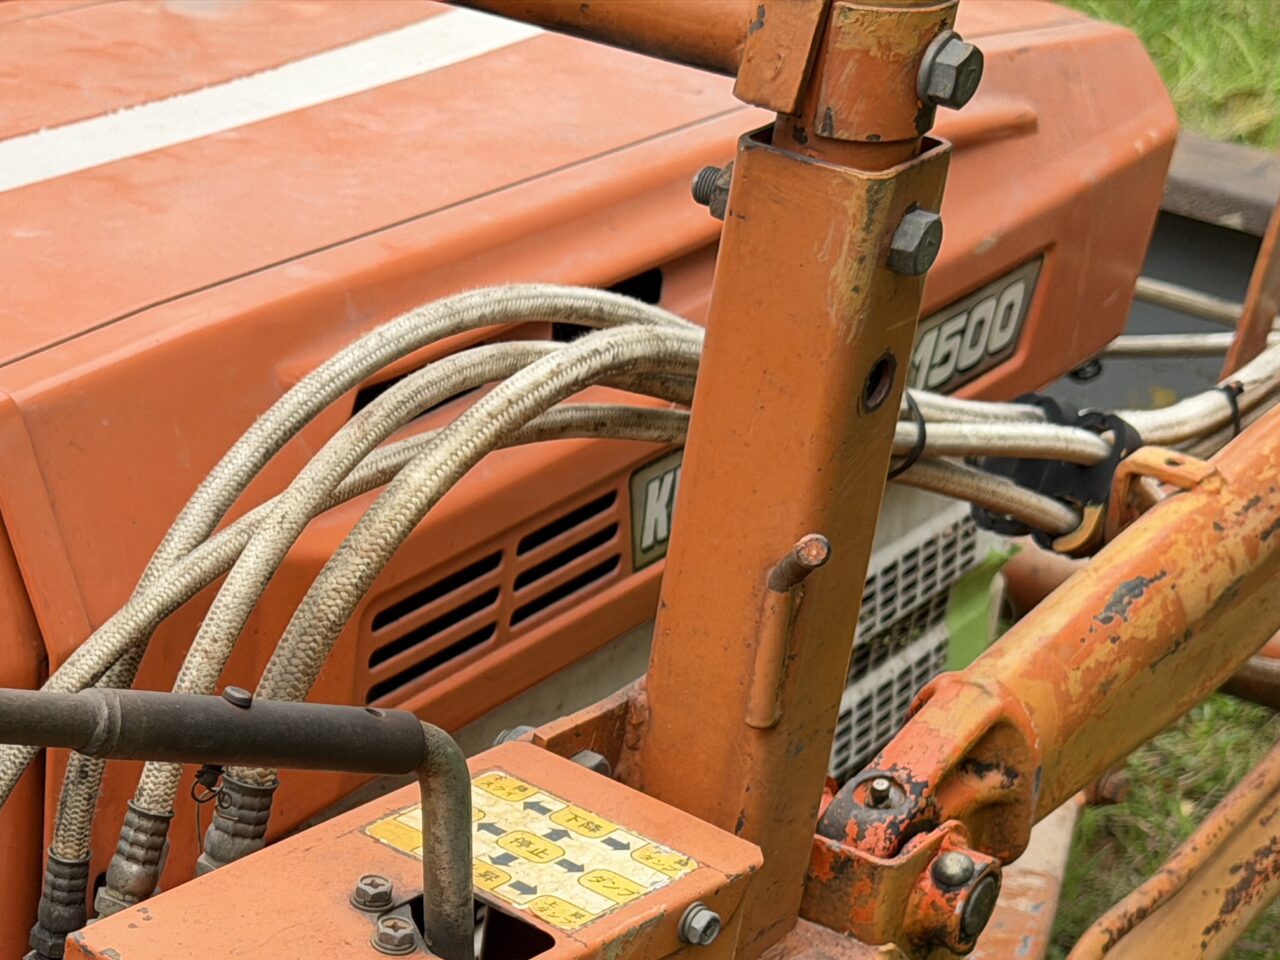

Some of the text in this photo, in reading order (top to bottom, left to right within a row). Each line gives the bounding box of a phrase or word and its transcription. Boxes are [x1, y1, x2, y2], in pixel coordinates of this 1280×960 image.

[913, 280, 1026, 389] 1500
[566, 812, 603, 833] 下降
[509, 837, 549, 858] 停止
[588, 876, 641, 896] ダンプ
